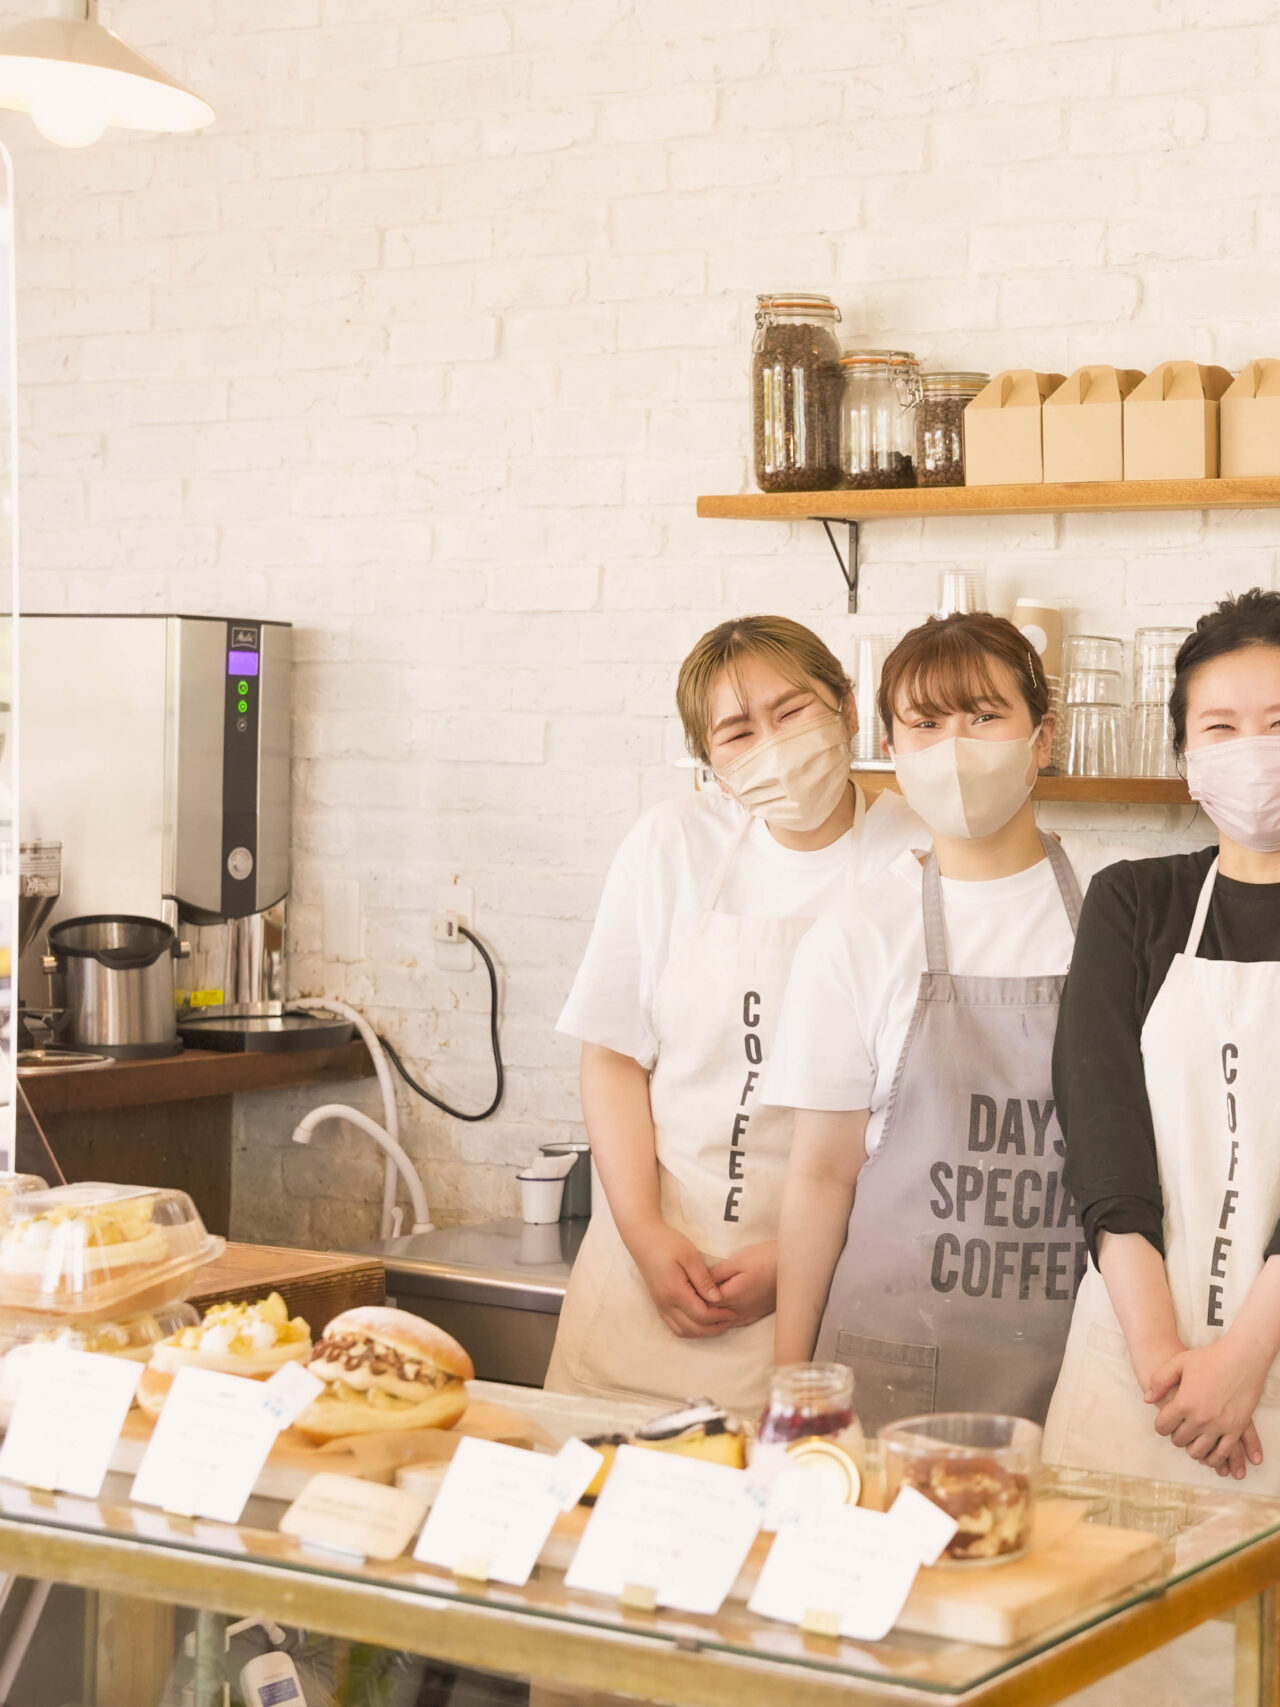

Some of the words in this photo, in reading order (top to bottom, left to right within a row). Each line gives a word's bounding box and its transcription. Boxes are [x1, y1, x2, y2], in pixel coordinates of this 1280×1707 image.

[723, 991, 763, 1223] COFFEE
[930, 1161, 1084, 1229] SPECIA
[1206, 1043, 1239, 1327] COFFEE
